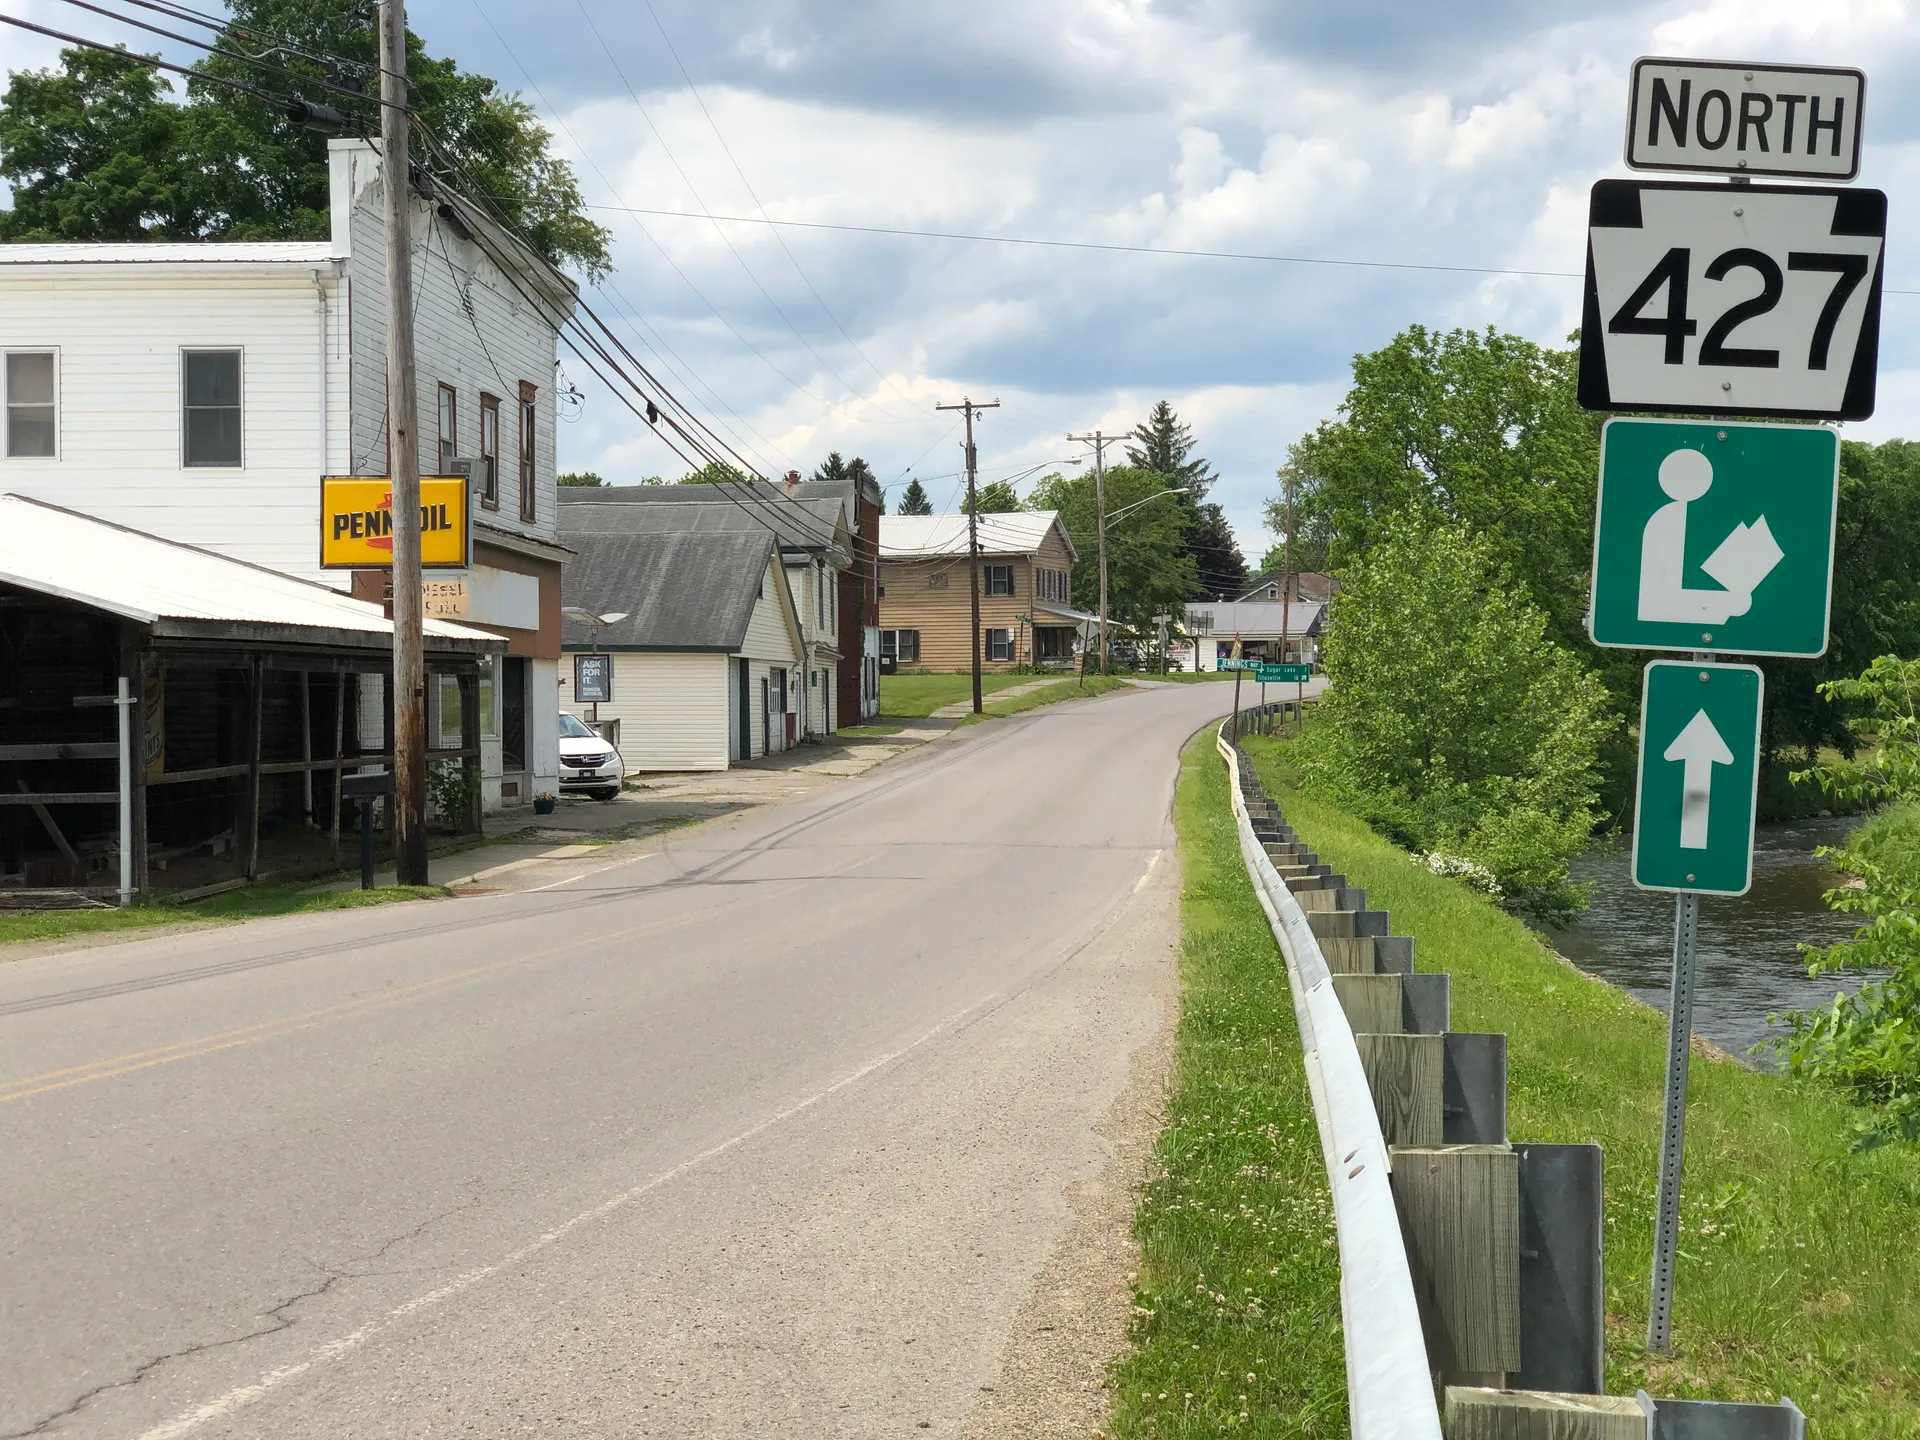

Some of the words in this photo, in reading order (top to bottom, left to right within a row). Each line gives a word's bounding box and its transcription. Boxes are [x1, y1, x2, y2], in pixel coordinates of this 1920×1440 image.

[1648, 78, 1845, 157] NORTH
[1608, 247, 1869, 371] 427
[333, 503, 452, 540] PENNOIL
